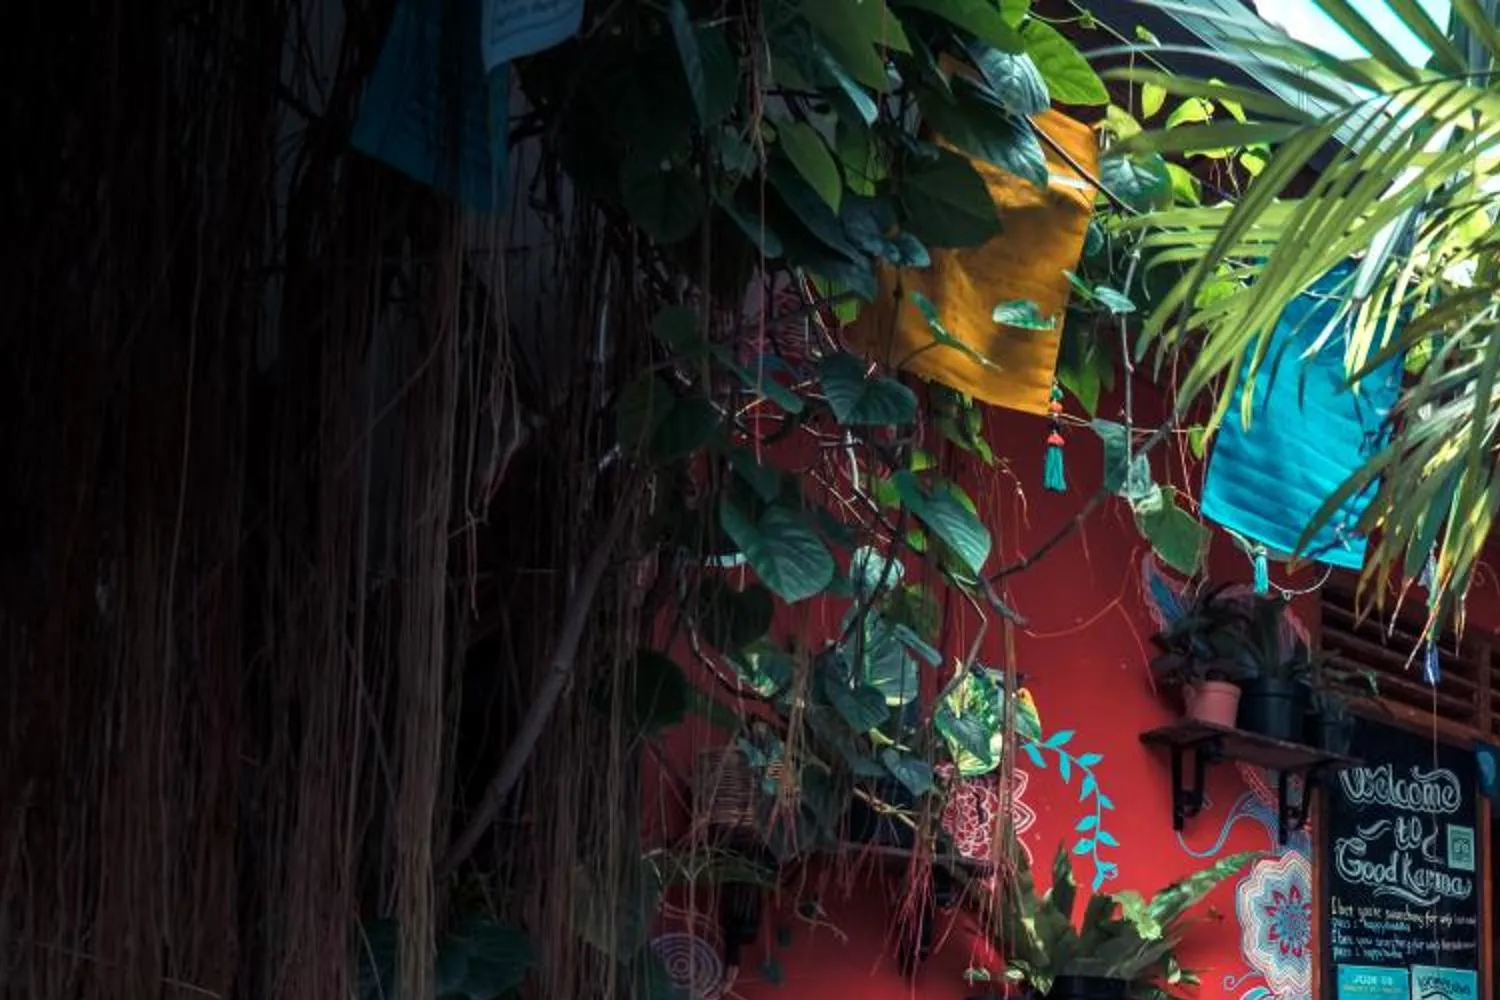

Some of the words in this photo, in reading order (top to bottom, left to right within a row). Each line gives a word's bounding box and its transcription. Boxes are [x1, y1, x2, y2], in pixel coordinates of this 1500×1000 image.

[1338, 763, 1461, 813] Welcome
[1394, 816, 1422, 850] to
[1334, 838, 1399, 884] Good
[1401, 852, 1472, 899] Karma
